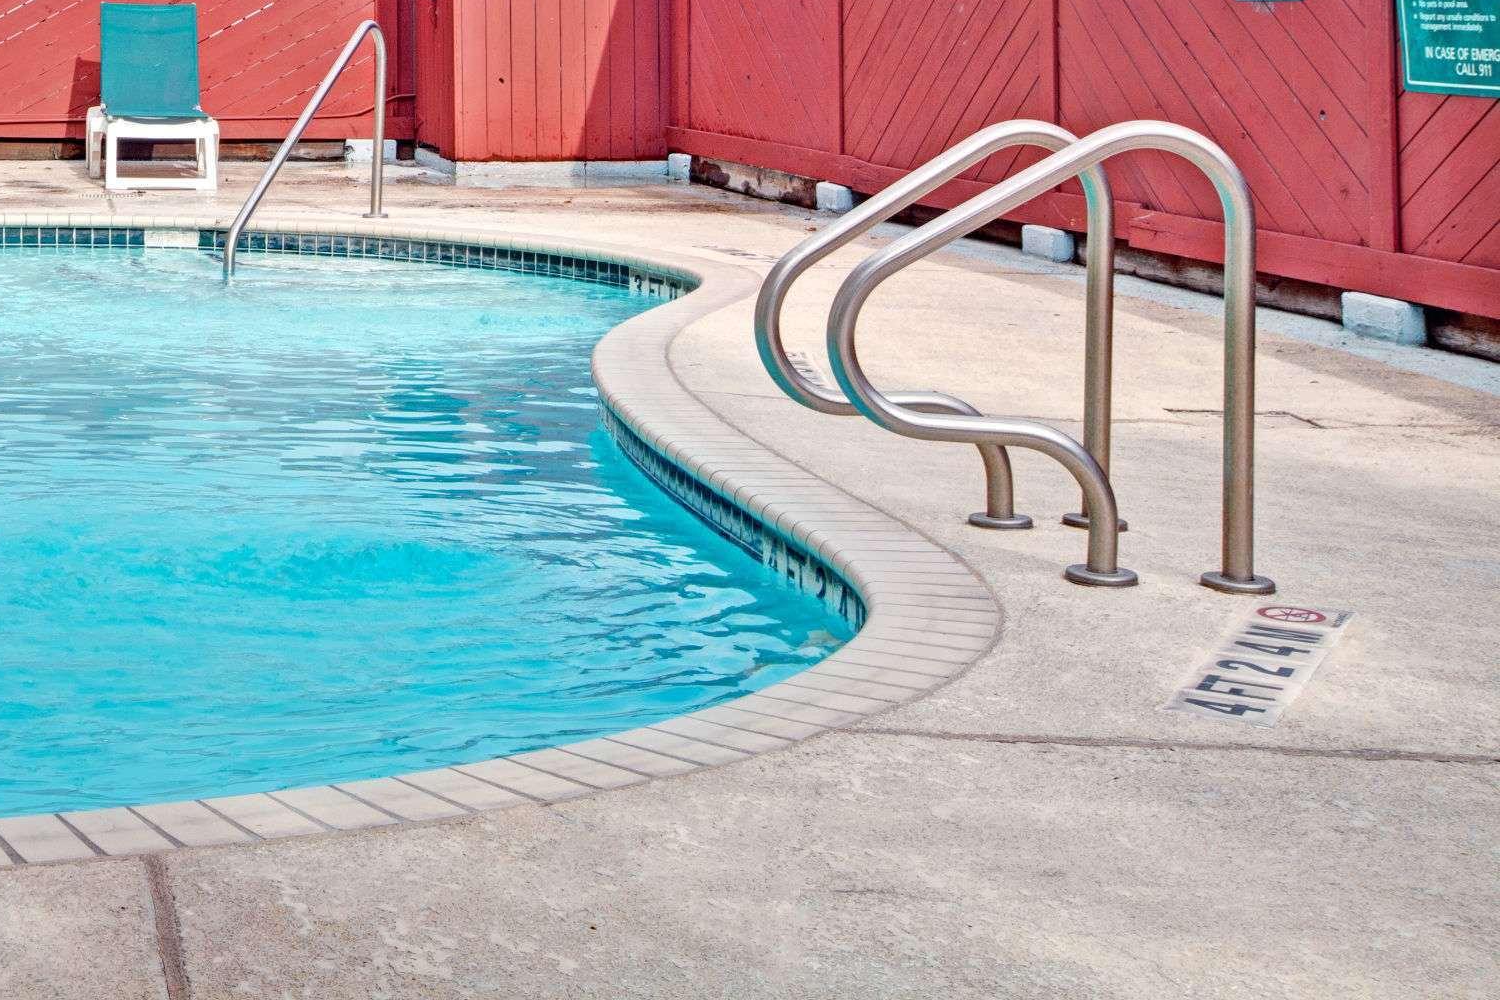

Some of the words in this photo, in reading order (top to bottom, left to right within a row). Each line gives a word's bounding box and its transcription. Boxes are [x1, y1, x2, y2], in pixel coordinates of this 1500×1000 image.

[1424, 46, 1434, 59] IN
[1434, 46, 1456, 60] CASE
[1457, 47, 1470, 61] OF
[1455, 62, 1478, 76] CALL
[1478, 63, 1492, 77] 911
